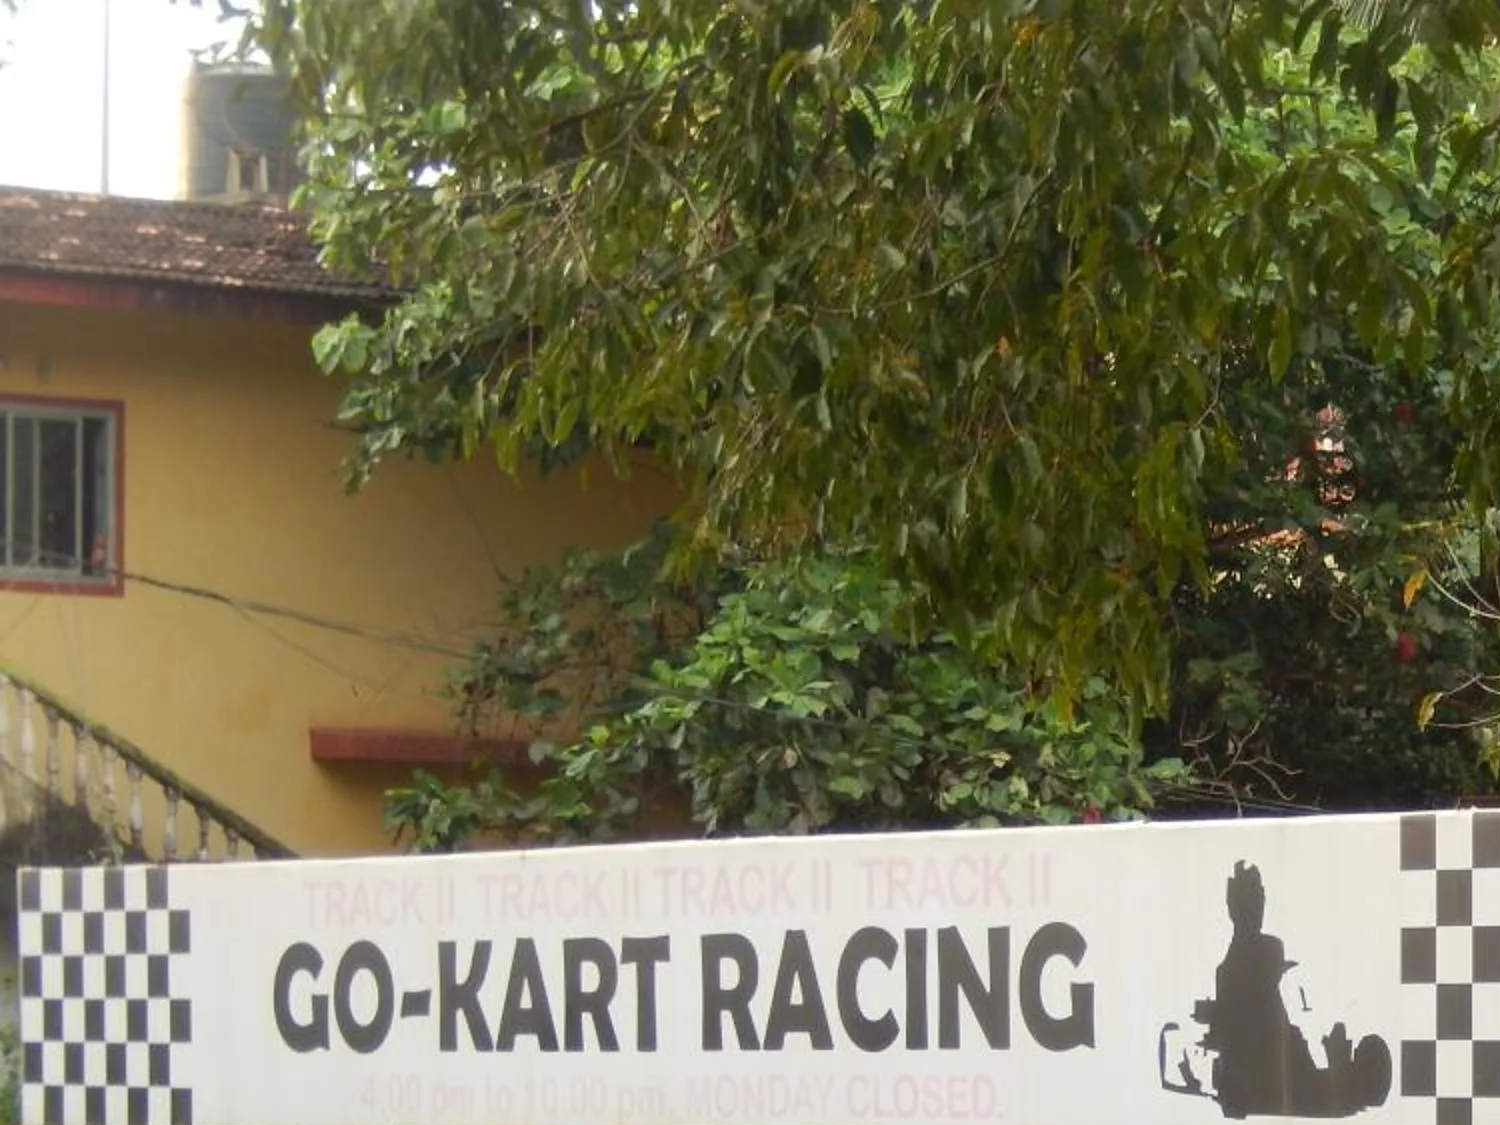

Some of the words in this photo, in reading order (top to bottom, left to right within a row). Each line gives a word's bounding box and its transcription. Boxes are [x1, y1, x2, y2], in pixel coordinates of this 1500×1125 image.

[302, 878, 424, 926] TRACK
[476, 871, 608, 923] TRACK
[653, 861, 797, 917] TRACK
[857, 854, 1013, 910] TRACK
[273, 935, 671, 1054] GO-KART
[700, 921, 1096, 1052] RACING
[484, 1074, 516, 1116] to
[686, 1072, 834, 1119] MONDAY
[846, 1074, 1004, 1120] CLOSED.
